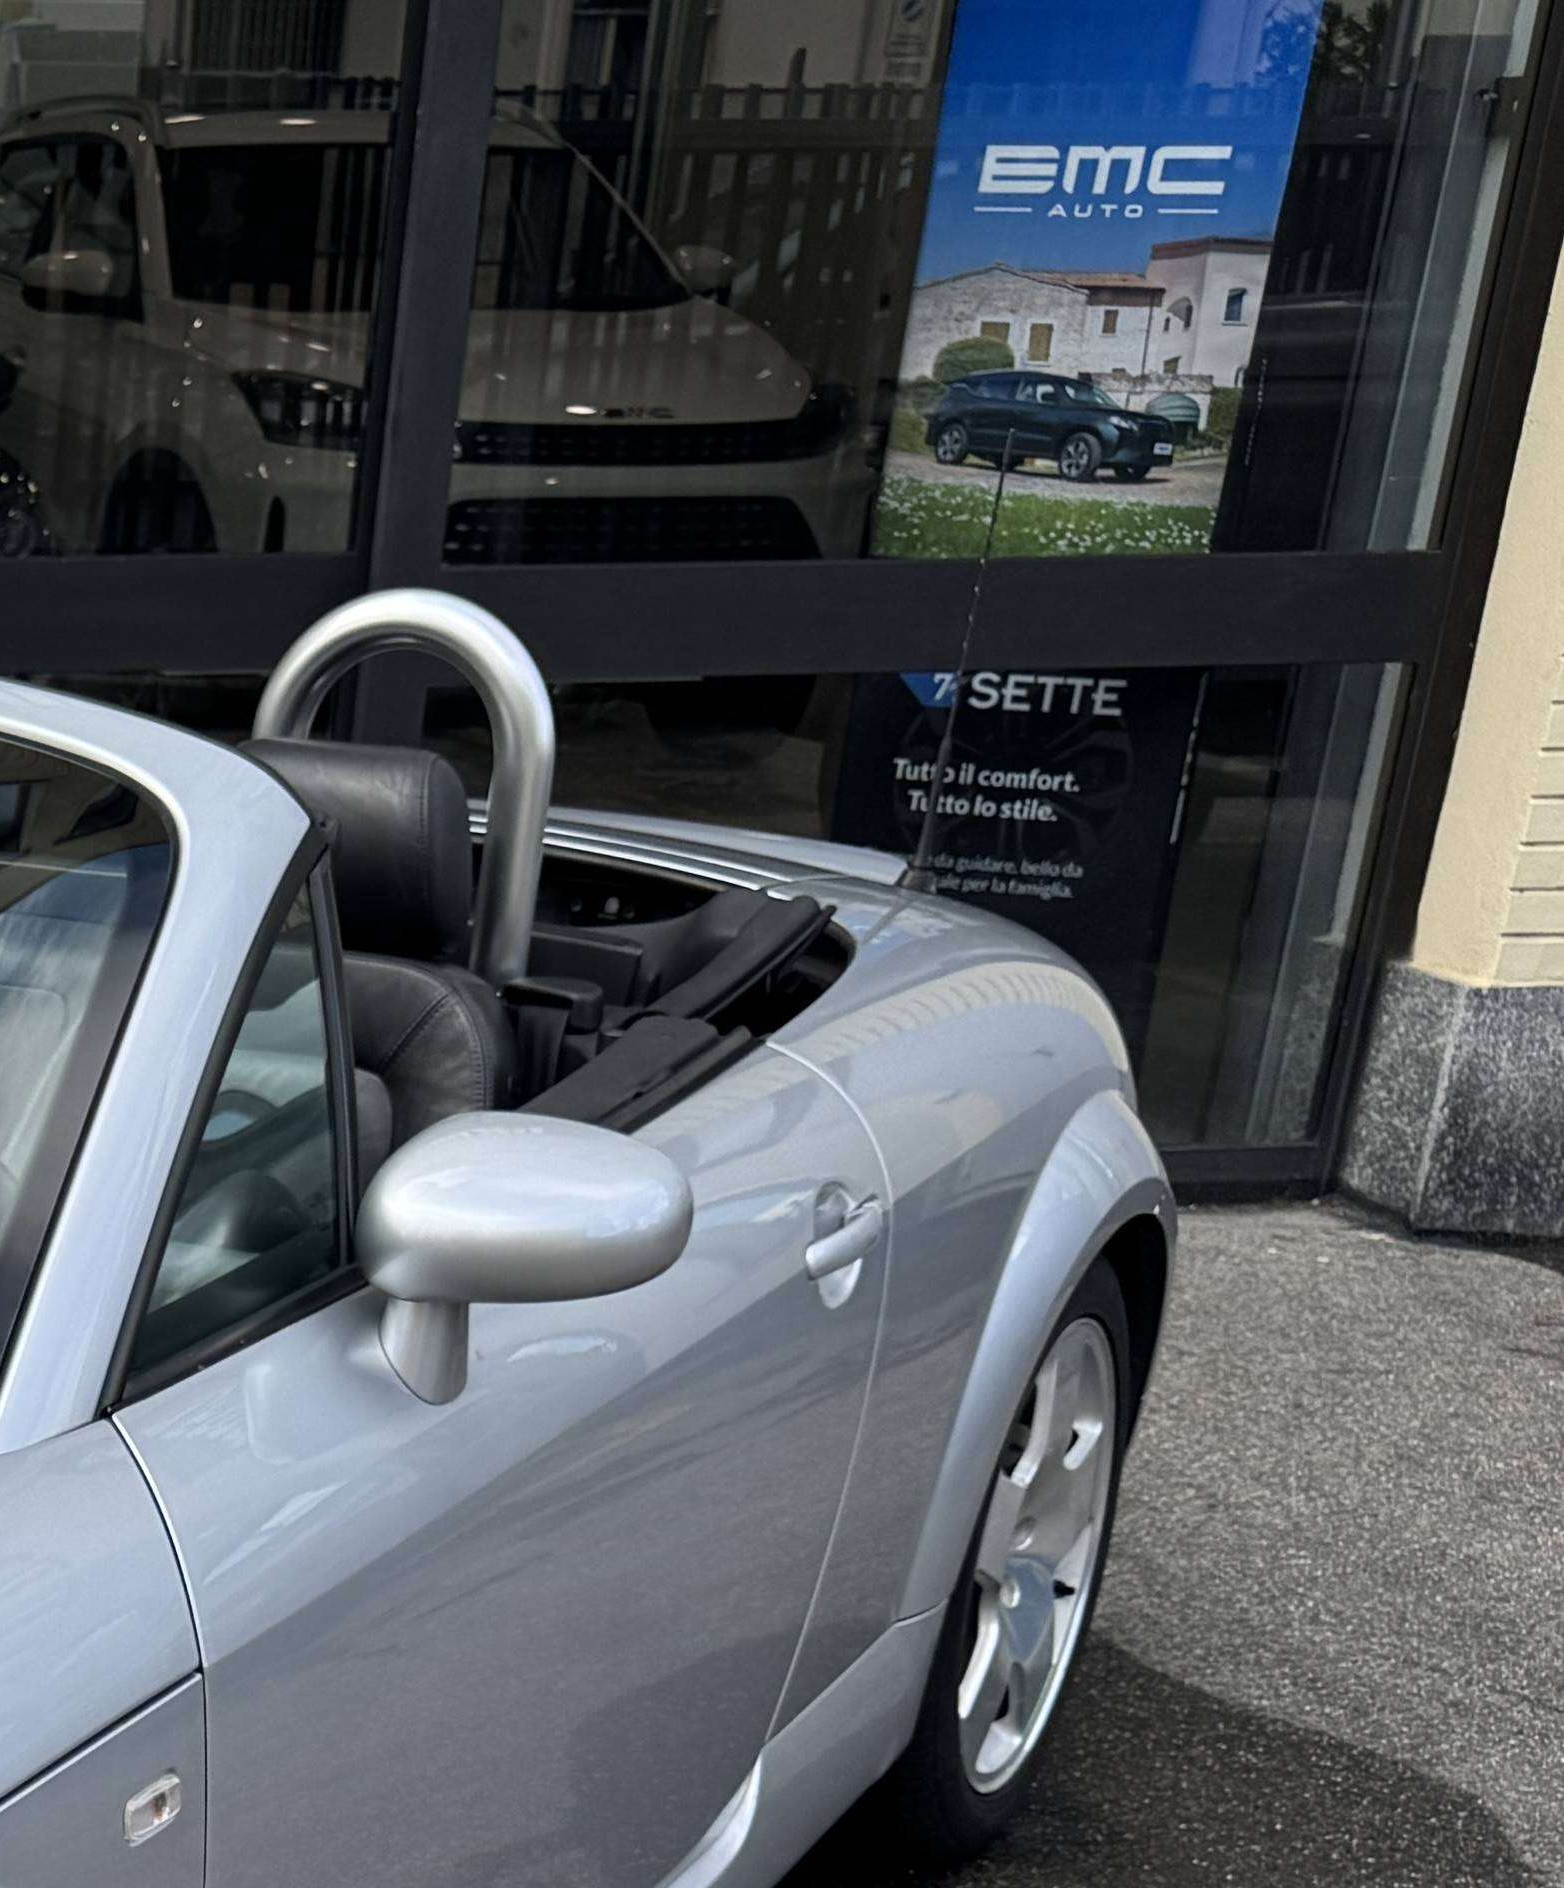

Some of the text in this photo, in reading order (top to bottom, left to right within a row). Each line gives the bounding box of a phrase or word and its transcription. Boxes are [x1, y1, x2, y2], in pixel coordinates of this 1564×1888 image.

[977, 145, 1232, 195] EMC
[1047, 203, 1144, 218] AUTO
[968, 671, 1127, 717] SETTE
[958, 762, 976, 785] il
[977, 768, 1081, 792] comfort.
[973, 794, 997, 818] lo
[999, 798, 1058, 822] stile.
